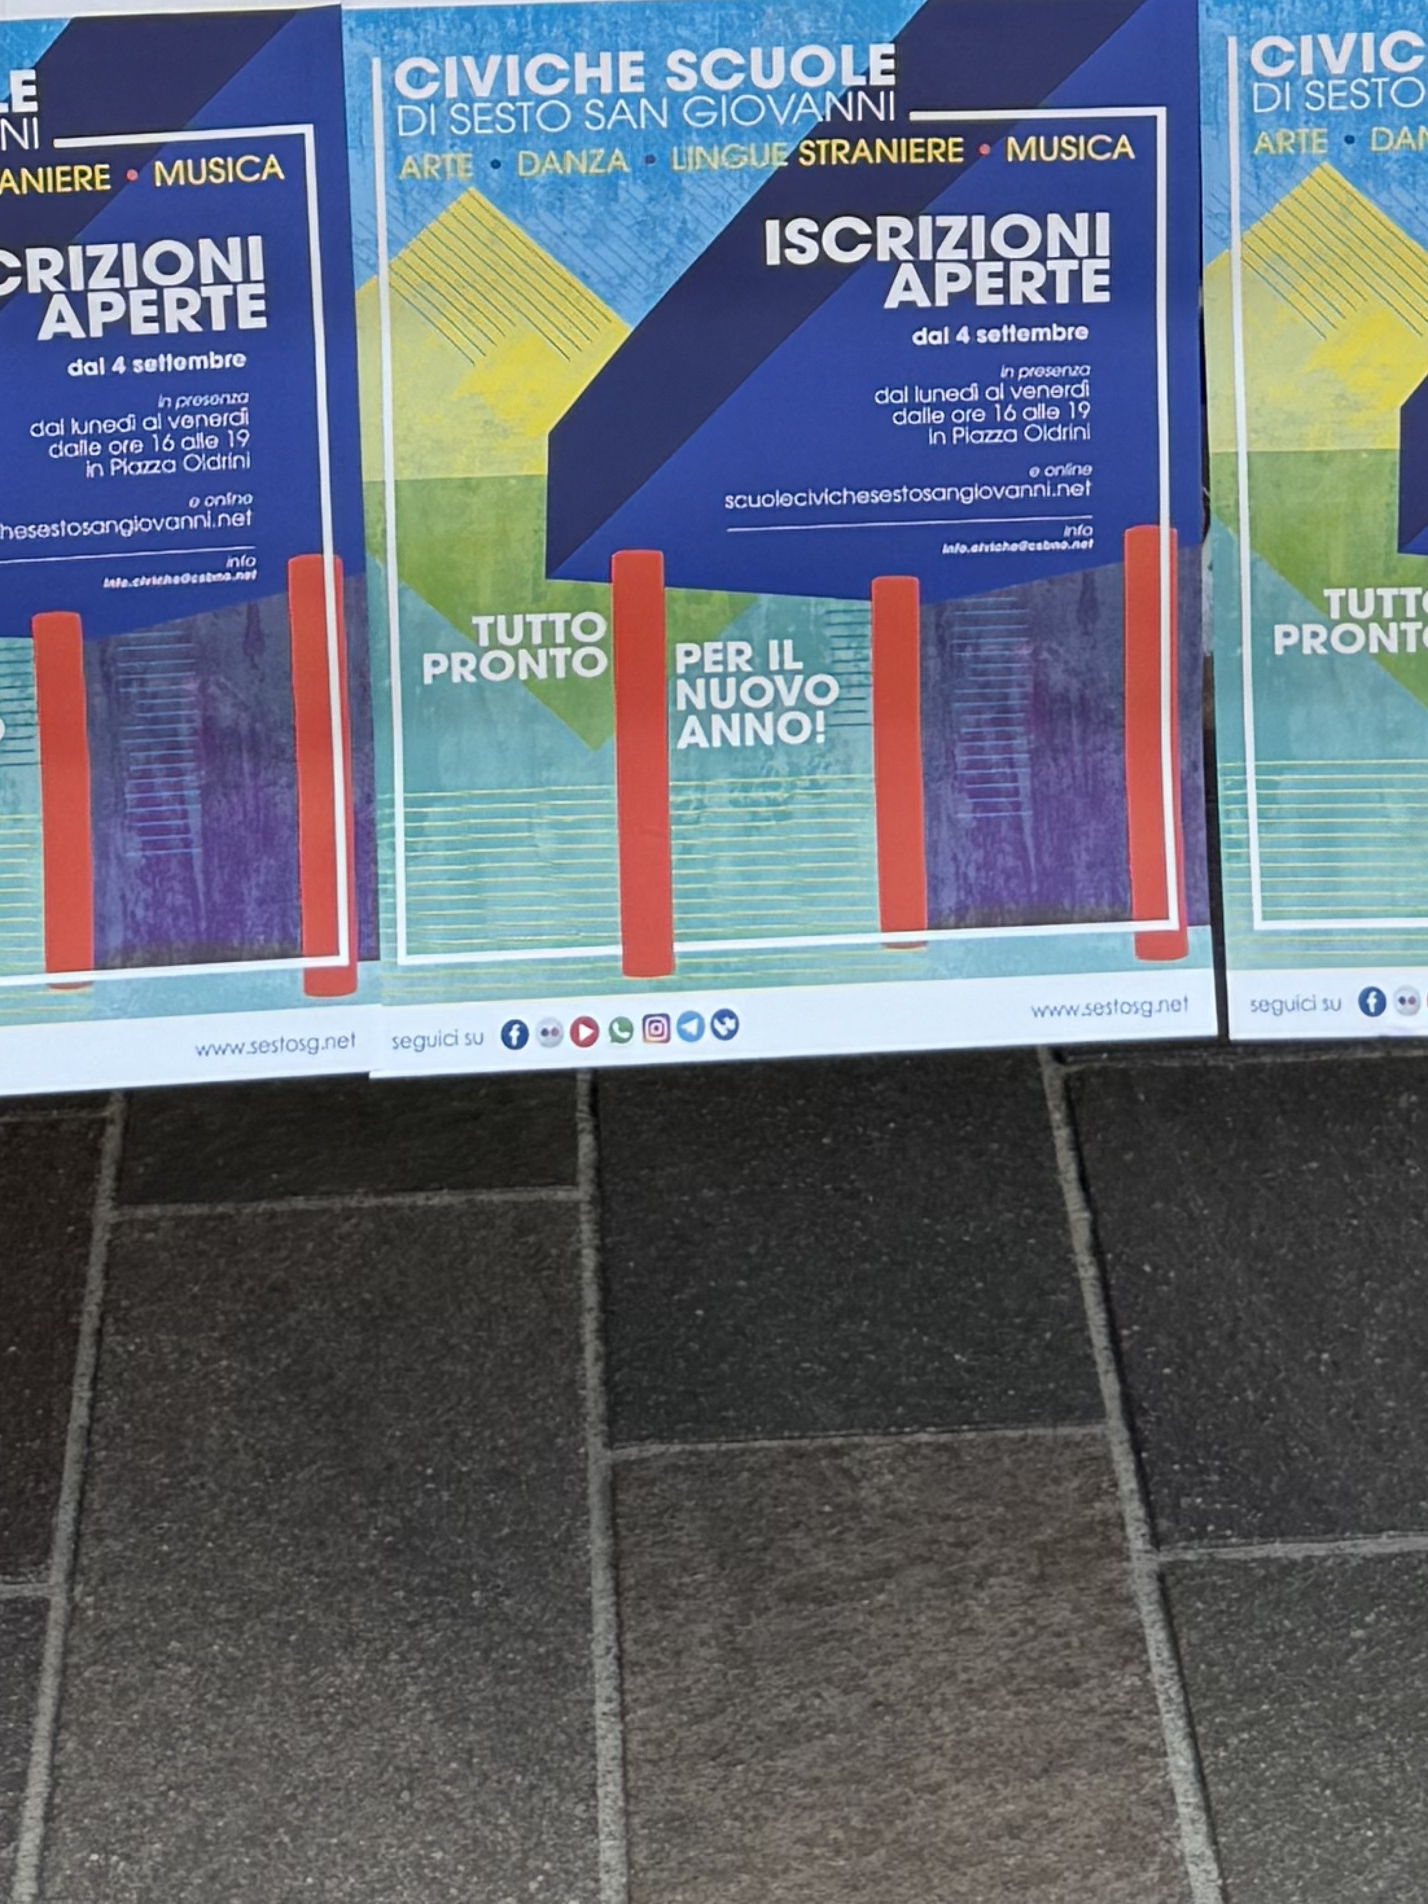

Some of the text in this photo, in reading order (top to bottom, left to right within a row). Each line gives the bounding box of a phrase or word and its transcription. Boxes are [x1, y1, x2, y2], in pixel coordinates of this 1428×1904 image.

[394, 43, 896, 99] CIVICHE SCUOLE
[397, 90, 896, 136] DI SESTO SAN GIOVANNI
[1252, 80, 1296, 113] DI
[1304, 76, 1425, 111] SESTO
[152, 153, 285, 186] MUSICA
[397, 132, 1134, 180] ARTE DANZA LINGUE STRANIERE MUSICA
[764, 210, 1110, 267] ISCRIZIONI
[882, 257, 1111, 310] APERTE
[33, 282, 269, 341] APERTE
[911, 322, 1089, 347] dal 4 settembre
[1000, 363, 1090, 383] in presenza
[874, 379, 1090, 405] dal lunedì al venerdì
[892, 400, 1090, 426] dalle ore 16 alle 19
[928, 421, 1091, 446] in Piazza Oldrini
[1028, 461, 1092, 477] e online
[724, 478, 1092, 512] scuolecivichesestosangiovanni.net
[1063, 523, 1092, 539] info
[471, 610, 607, 648] TUTTO
[422, 645, 608, 685] PRONTO
[675, 638, 803, 676] PER IL
[675, 671, 840, 714] NUOVO
[676, 708, 826, 750] ANNO!
[1031, 994, 1189, 1023] www.sestosg.net
[391, 1030, 486, 1054] seguici su
